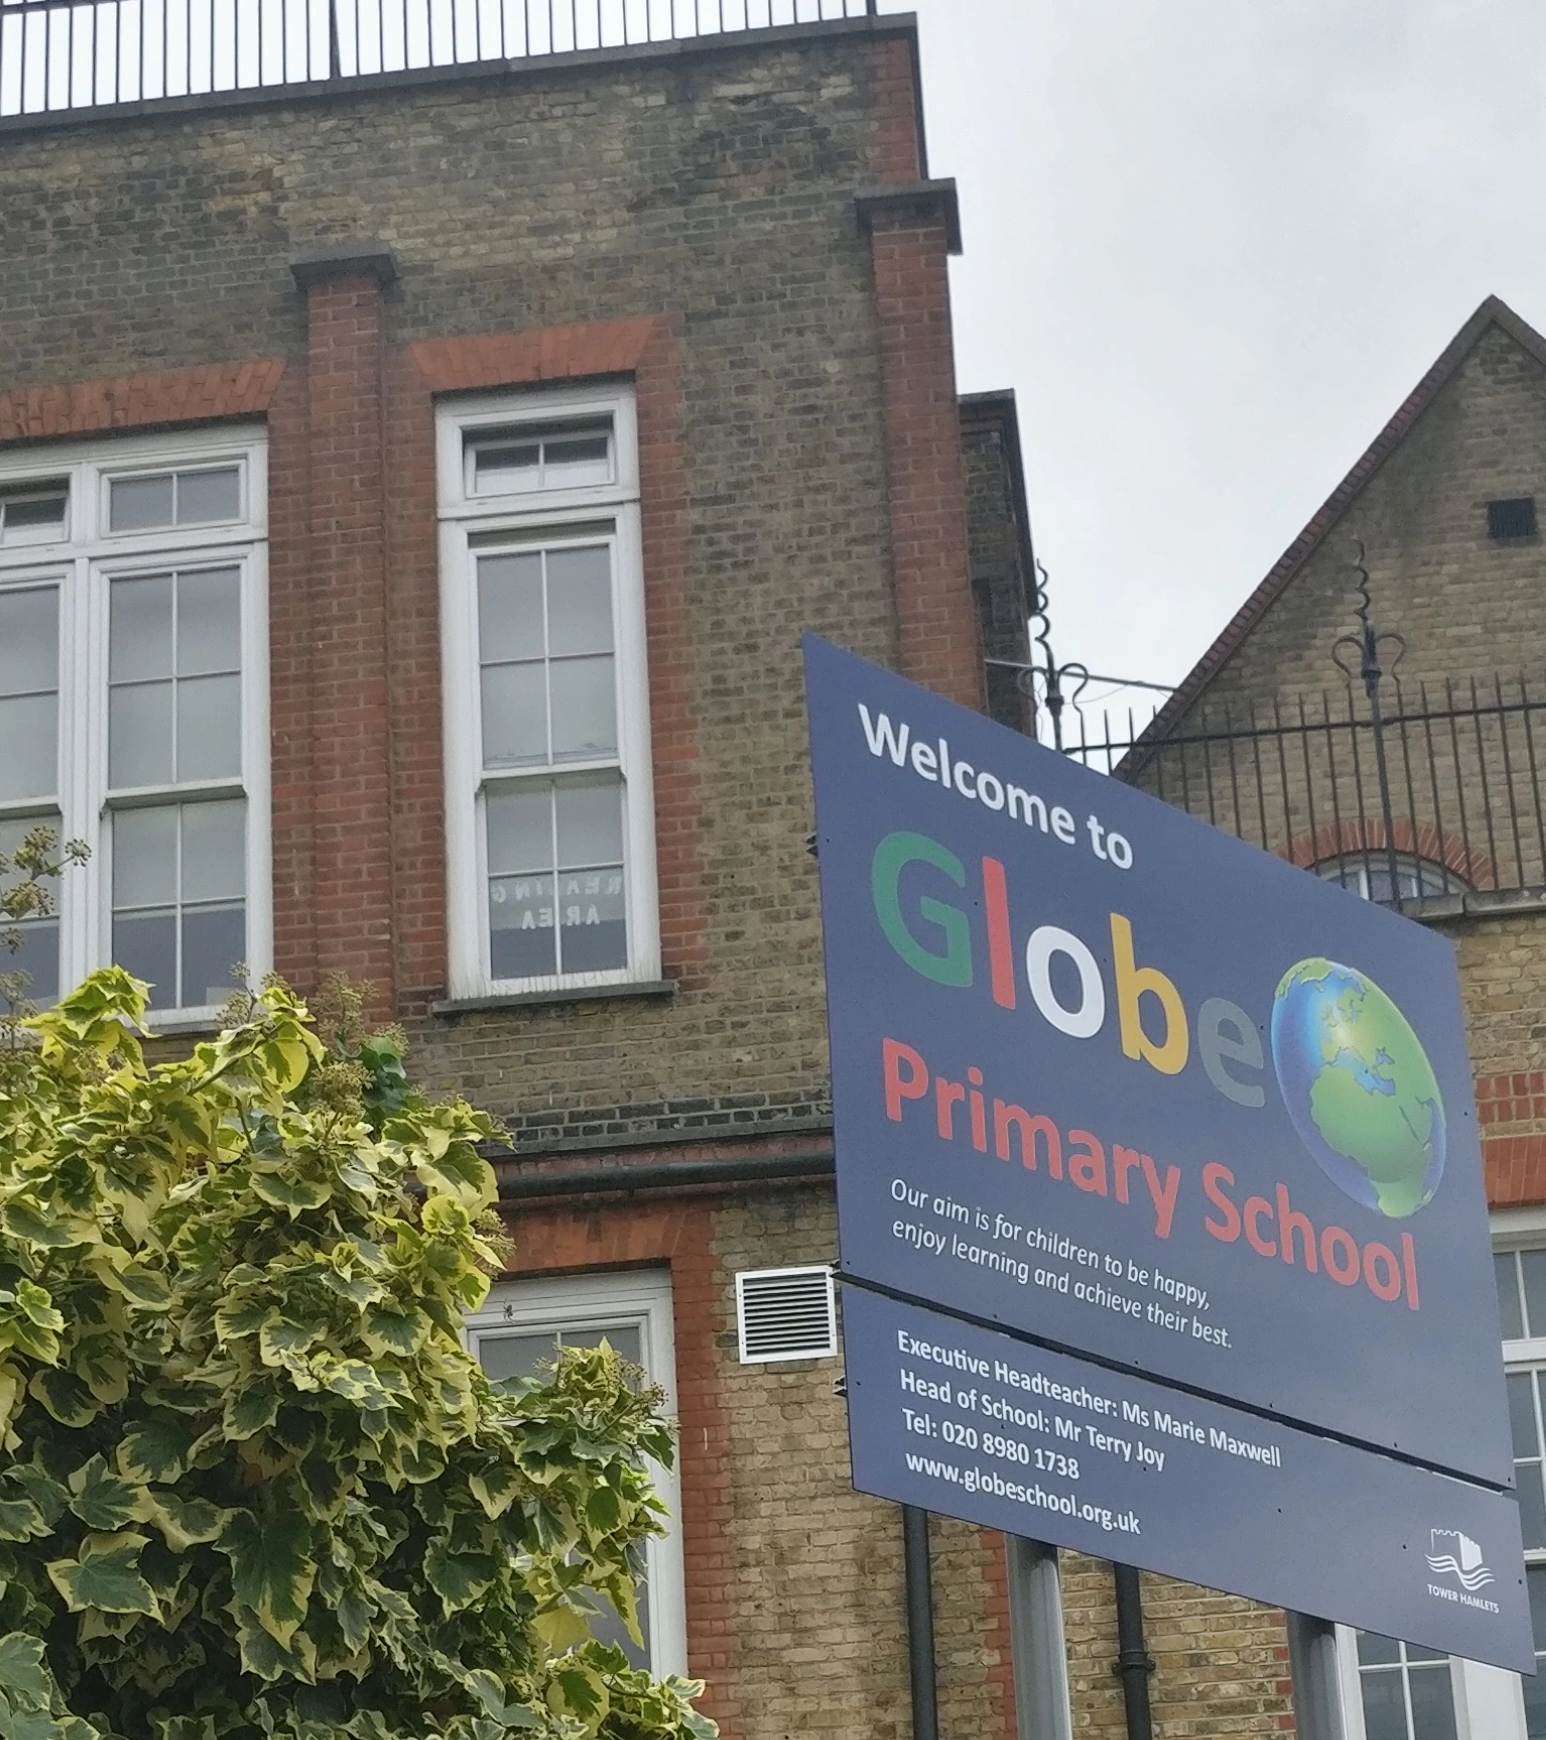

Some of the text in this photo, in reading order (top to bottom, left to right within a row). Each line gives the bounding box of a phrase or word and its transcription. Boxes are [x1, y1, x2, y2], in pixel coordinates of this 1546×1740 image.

[858, 702, 1134, 869] Welcome to
[871, 831, 1266, 1108] Globe
[882, 1038, 1419, 1311] Primary School
[891, 1179, 1211, 1311] Our aim is for children to be happy,
[893, 1219, 1233, 1349] enjoy learning and achieve their best.
[897, 1330, 1281, 1468] Executive Headteacher: Ms Marie Maxwell
[900, 1369, 1165, 1472] Head of School: Mr Terry Joy
[902, 1408, 1080, 1479] Tel: 020 8980 1738
[905, 1452, 1141, 1535] www.globeschool.org.uk
[1427, 1583, 1499, 1614] TOWER HAMLETS
